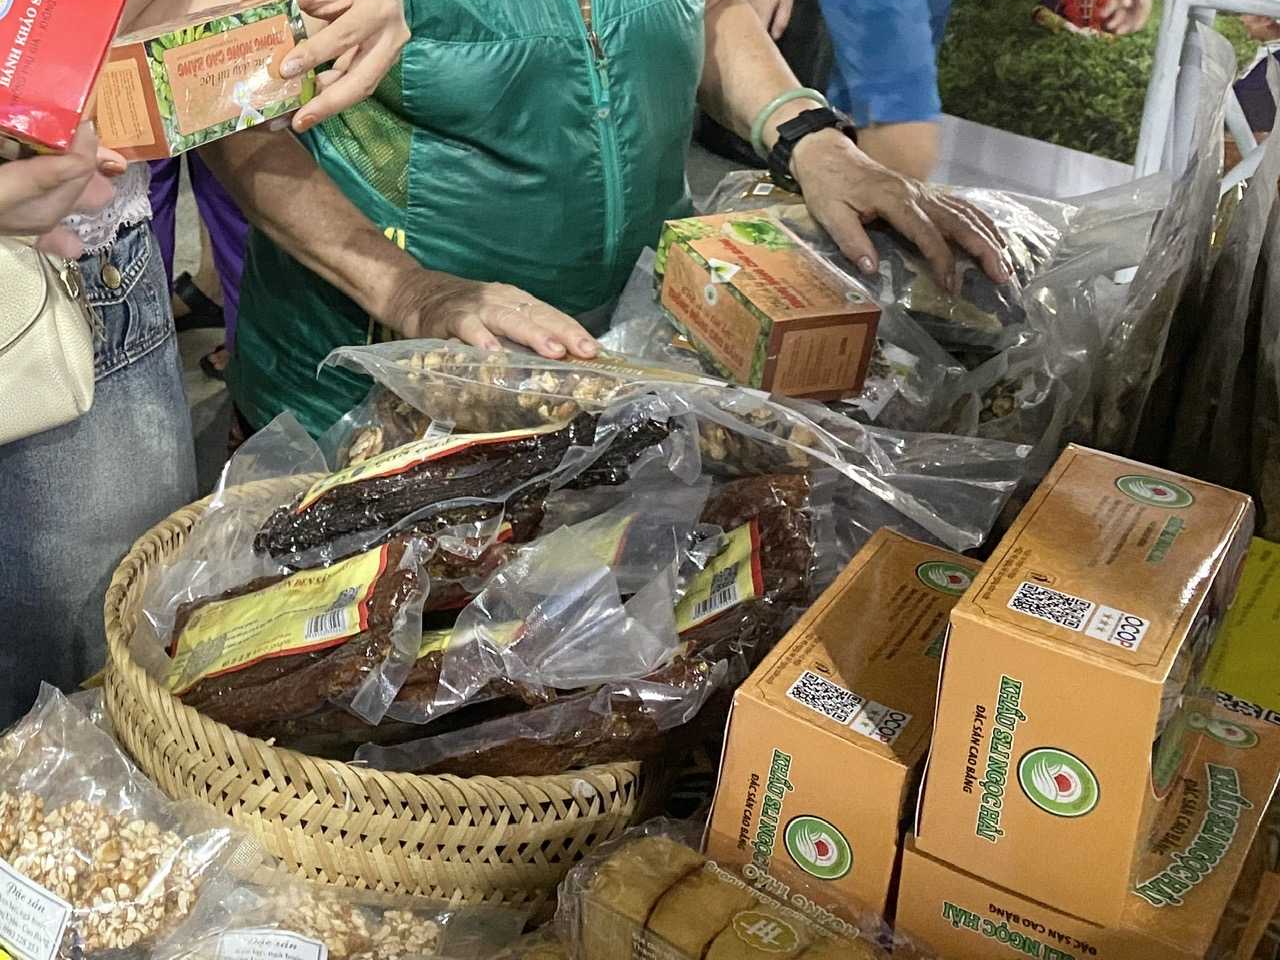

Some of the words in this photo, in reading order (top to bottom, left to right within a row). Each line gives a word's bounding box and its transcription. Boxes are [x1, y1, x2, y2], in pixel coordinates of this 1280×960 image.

[14, 7, 39, 46] KHẢO
[1119, 615, 1145, 649] OCOP
[877, 711, 906, 743] OCOP
[973, 704, 987, 727] ĐẶC
[971, 727, 985, 746] SẢN
[990, 727, 1013, 760] SLI
[968, 746, 979, 766] CAO
[978, 755, 1009, 809] NGỌC
[745, 791, 757, 809] SẢN
[760, 794, 782, 824] SLI
[741, 808, 752, 827] CAO
[976, 804, 1004, 843] HẢI
[742, 863, 791, 900] THẢO
[791, 894, 861, 940] HOÀNG
[941, 900, 981, 931] HẢI
[1022, 918, 1046, 934] CAO
[981, 918, 1042, 959] NGỌC
